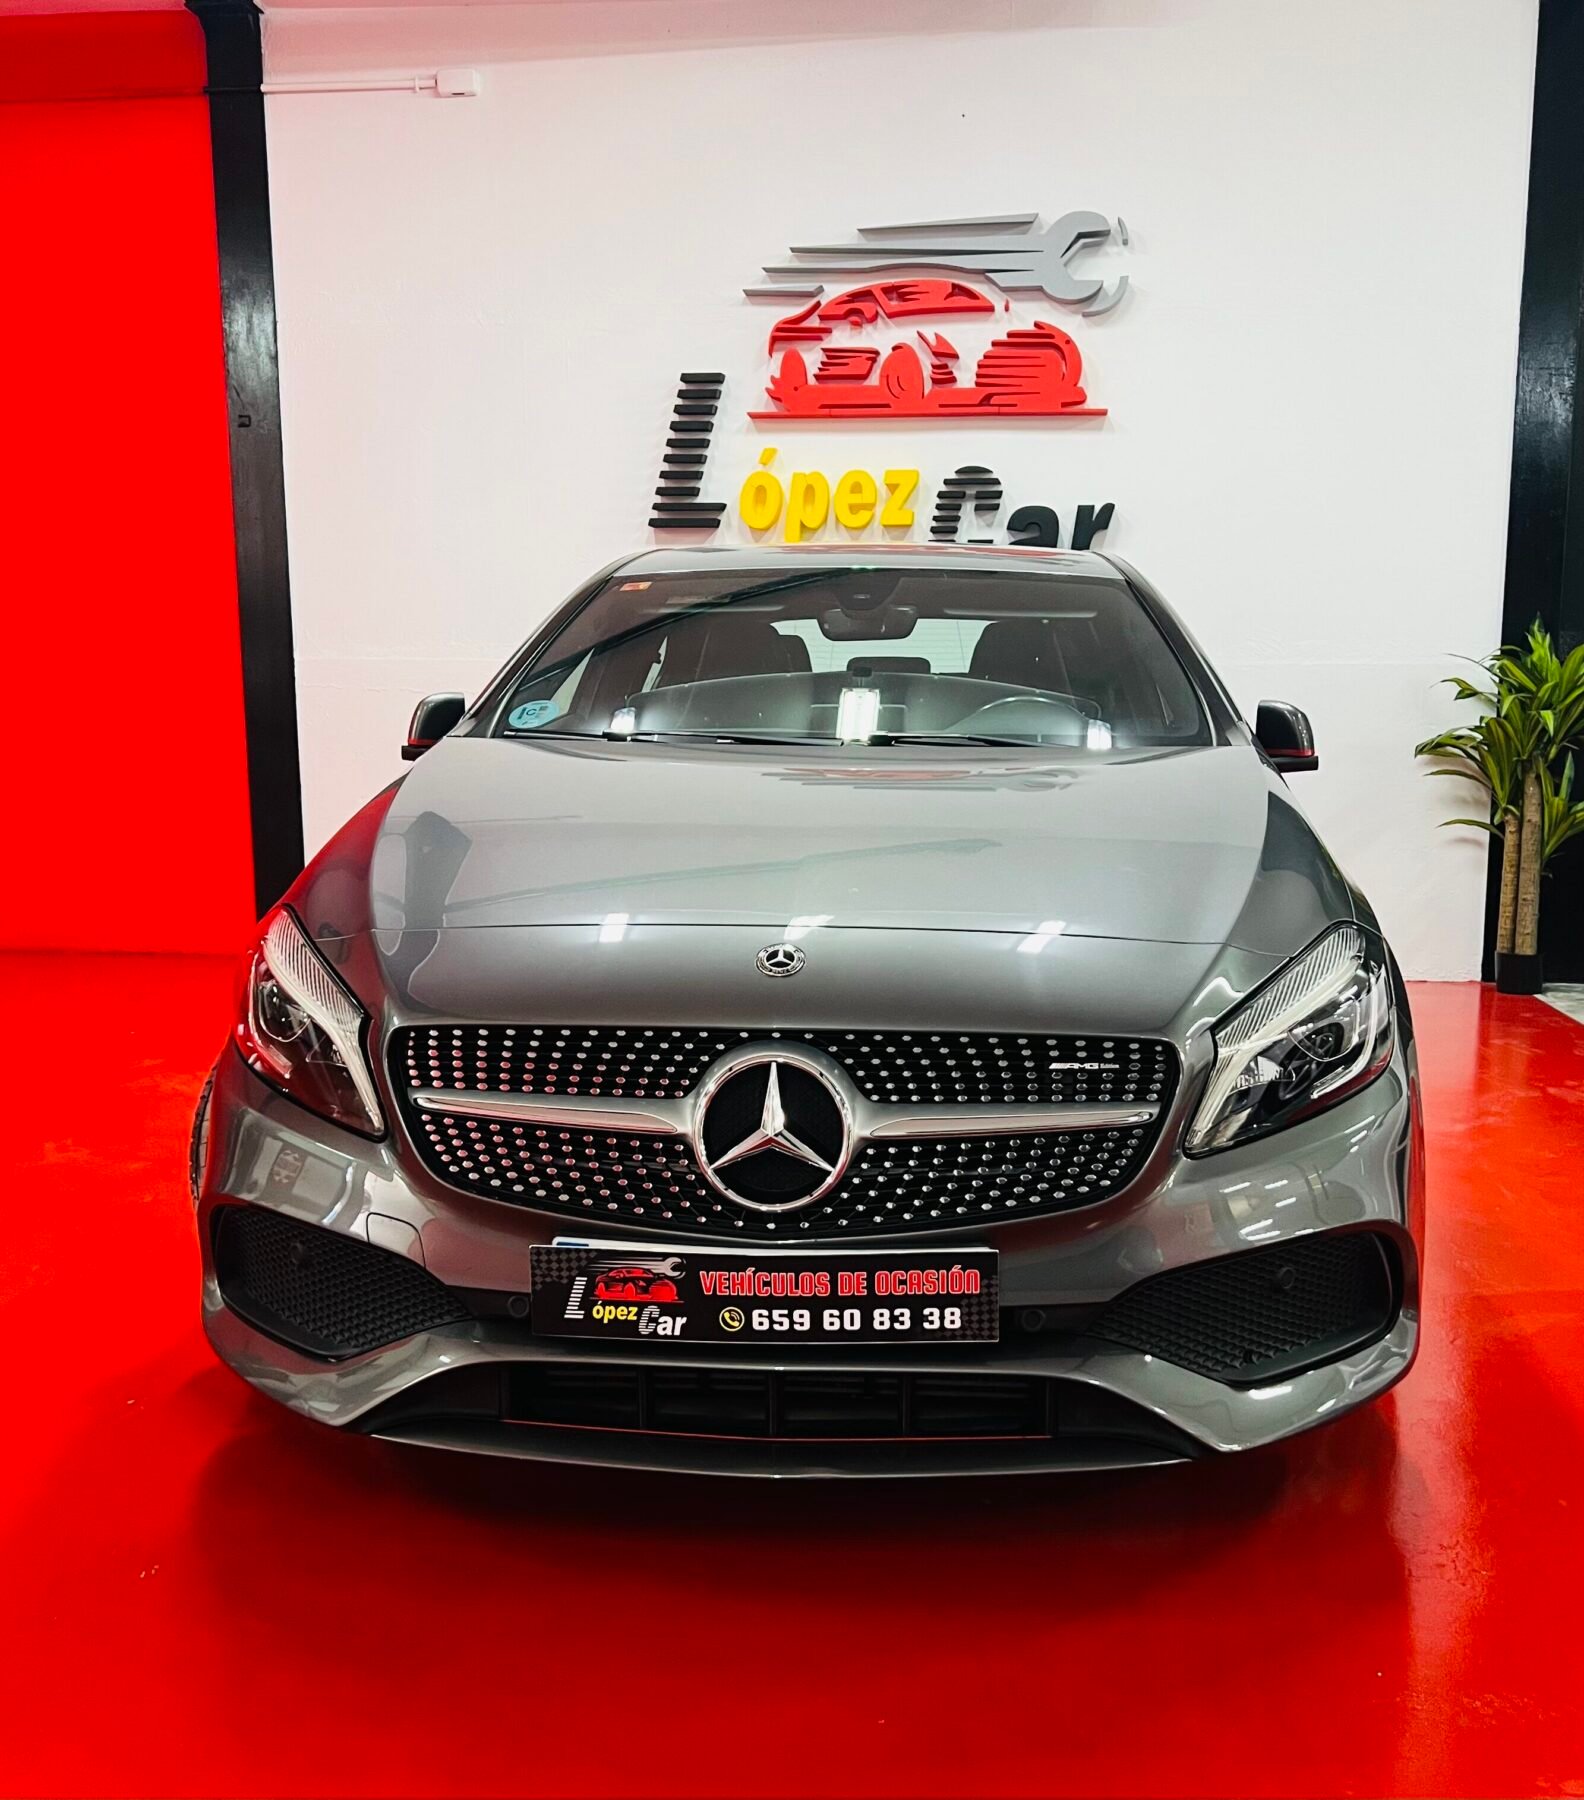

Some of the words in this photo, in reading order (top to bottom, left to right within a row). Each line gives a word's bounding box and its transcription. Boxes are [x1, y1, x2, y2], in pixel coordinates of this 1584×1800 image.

[648, 373, 920, 542] López
[928, 466, 1115, 550] Car
[699, 1268, 831, 1297] VEHÍCULOS
[838, 1271, 868, 1296] DE
[875, 1265, 981, 1295] OCASIÓN
[564, 1277, 638, 1324] López
[638, 1305, 687, 1336] Car
[752, 1308, 811, 1331] 659
[822, 1308, 861, 1331] 60
[873, 1307, 911, 1330] 83
[923, 1306, 962, 1329] 38
